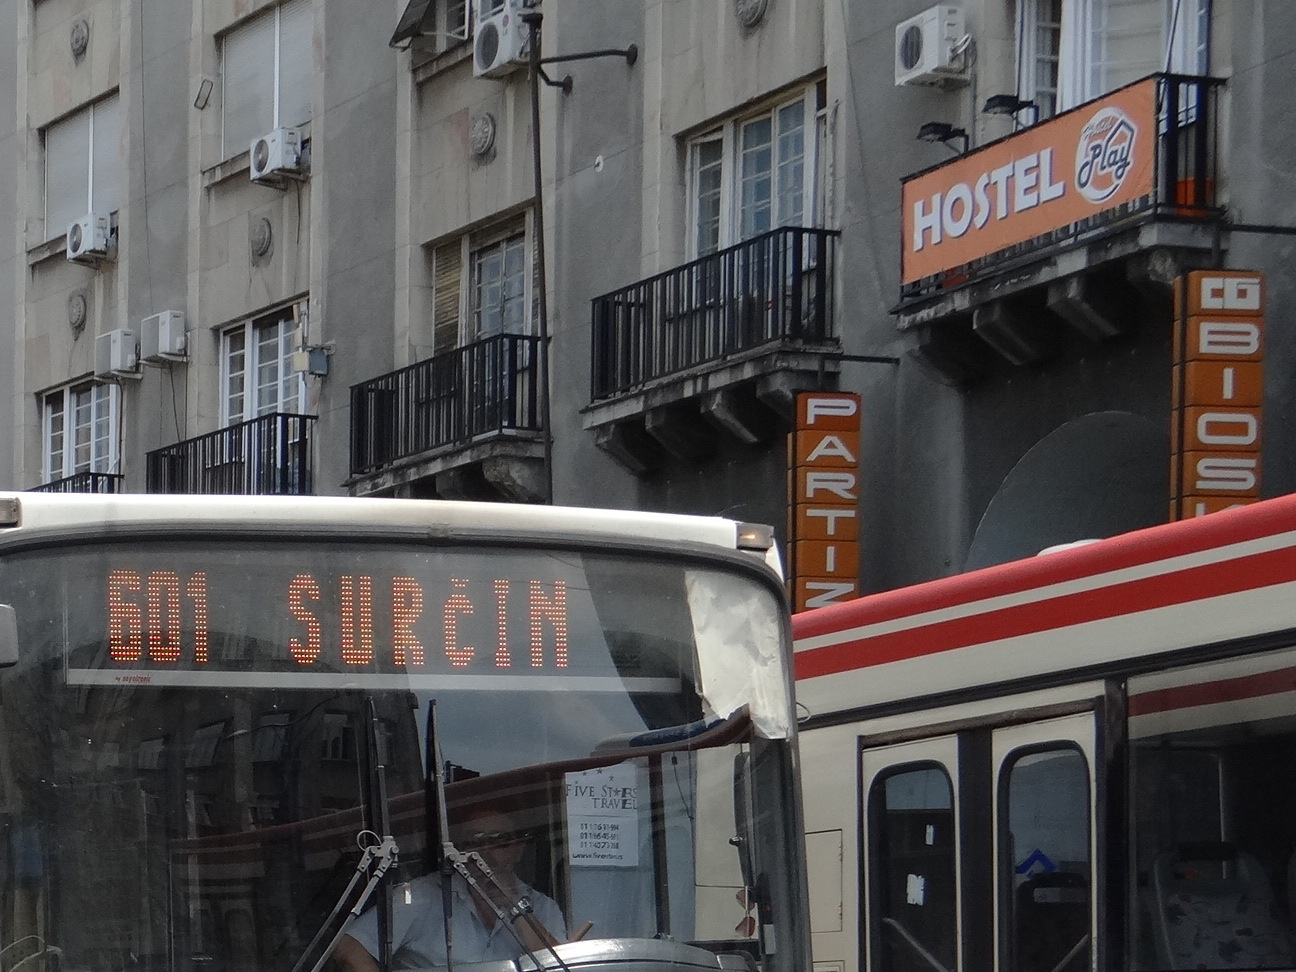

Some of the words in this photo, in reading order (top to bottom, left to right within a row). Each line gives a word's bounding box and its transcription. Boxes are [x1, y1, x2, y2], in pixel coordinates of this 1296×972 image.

[913, 147, 1065, 252] HOSTEL
[1078, 119, 1134, 189] Play
[109, 570, 208, 663] 601
[592, 797, 637, 810] TRAVEL
